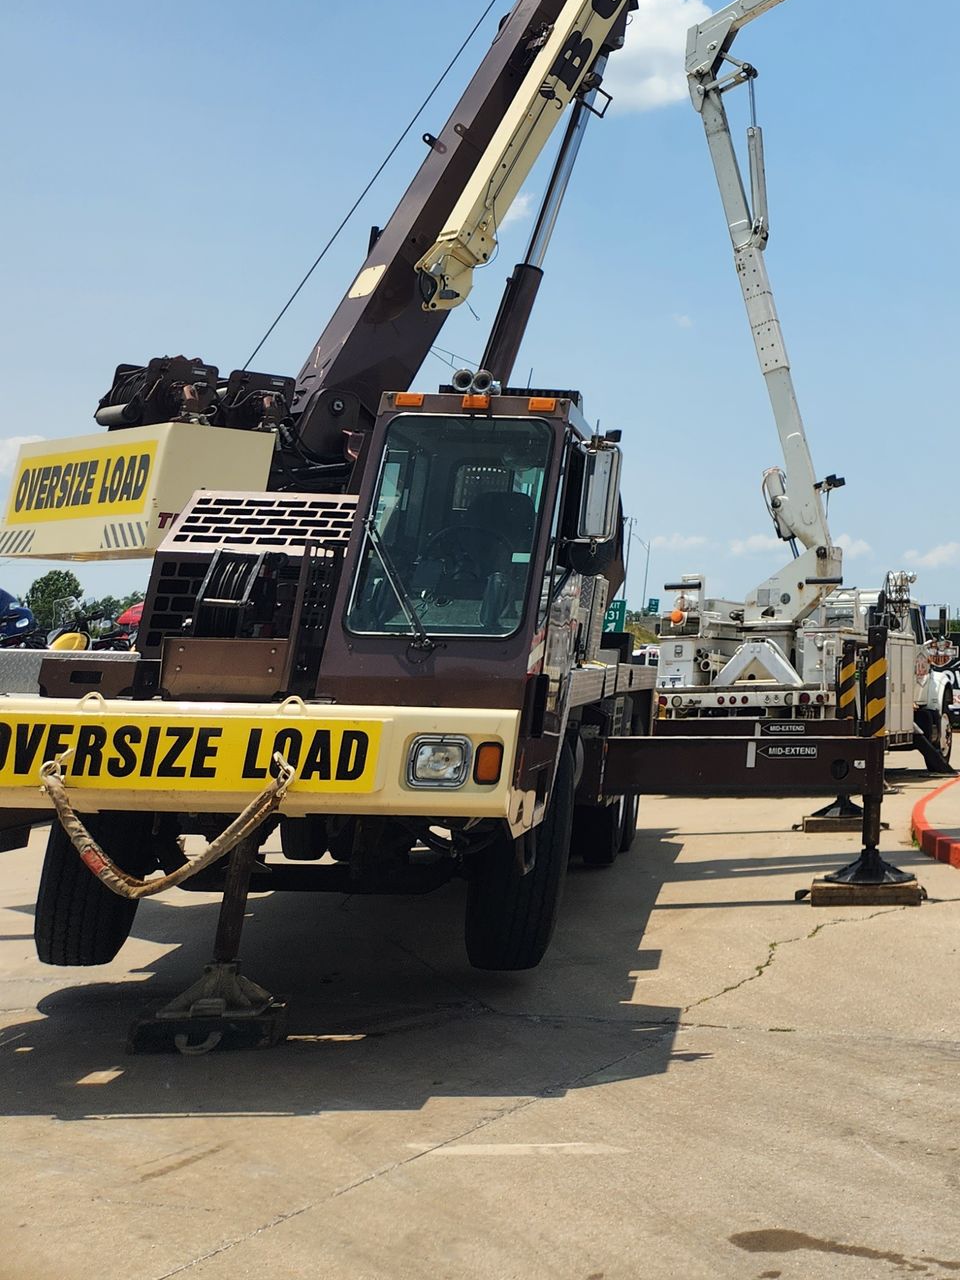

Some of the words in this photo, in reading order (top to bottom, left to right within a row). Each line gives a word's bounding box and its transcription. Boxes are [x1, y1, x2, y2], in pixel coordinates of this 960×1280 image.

[15, 459, 99, 513] OVERSIZE
[98, 453, 150, 504] LOAD
[241, 728, 370, 781] LOAD
[768, 746, 817, 755] MID-EXTEND
